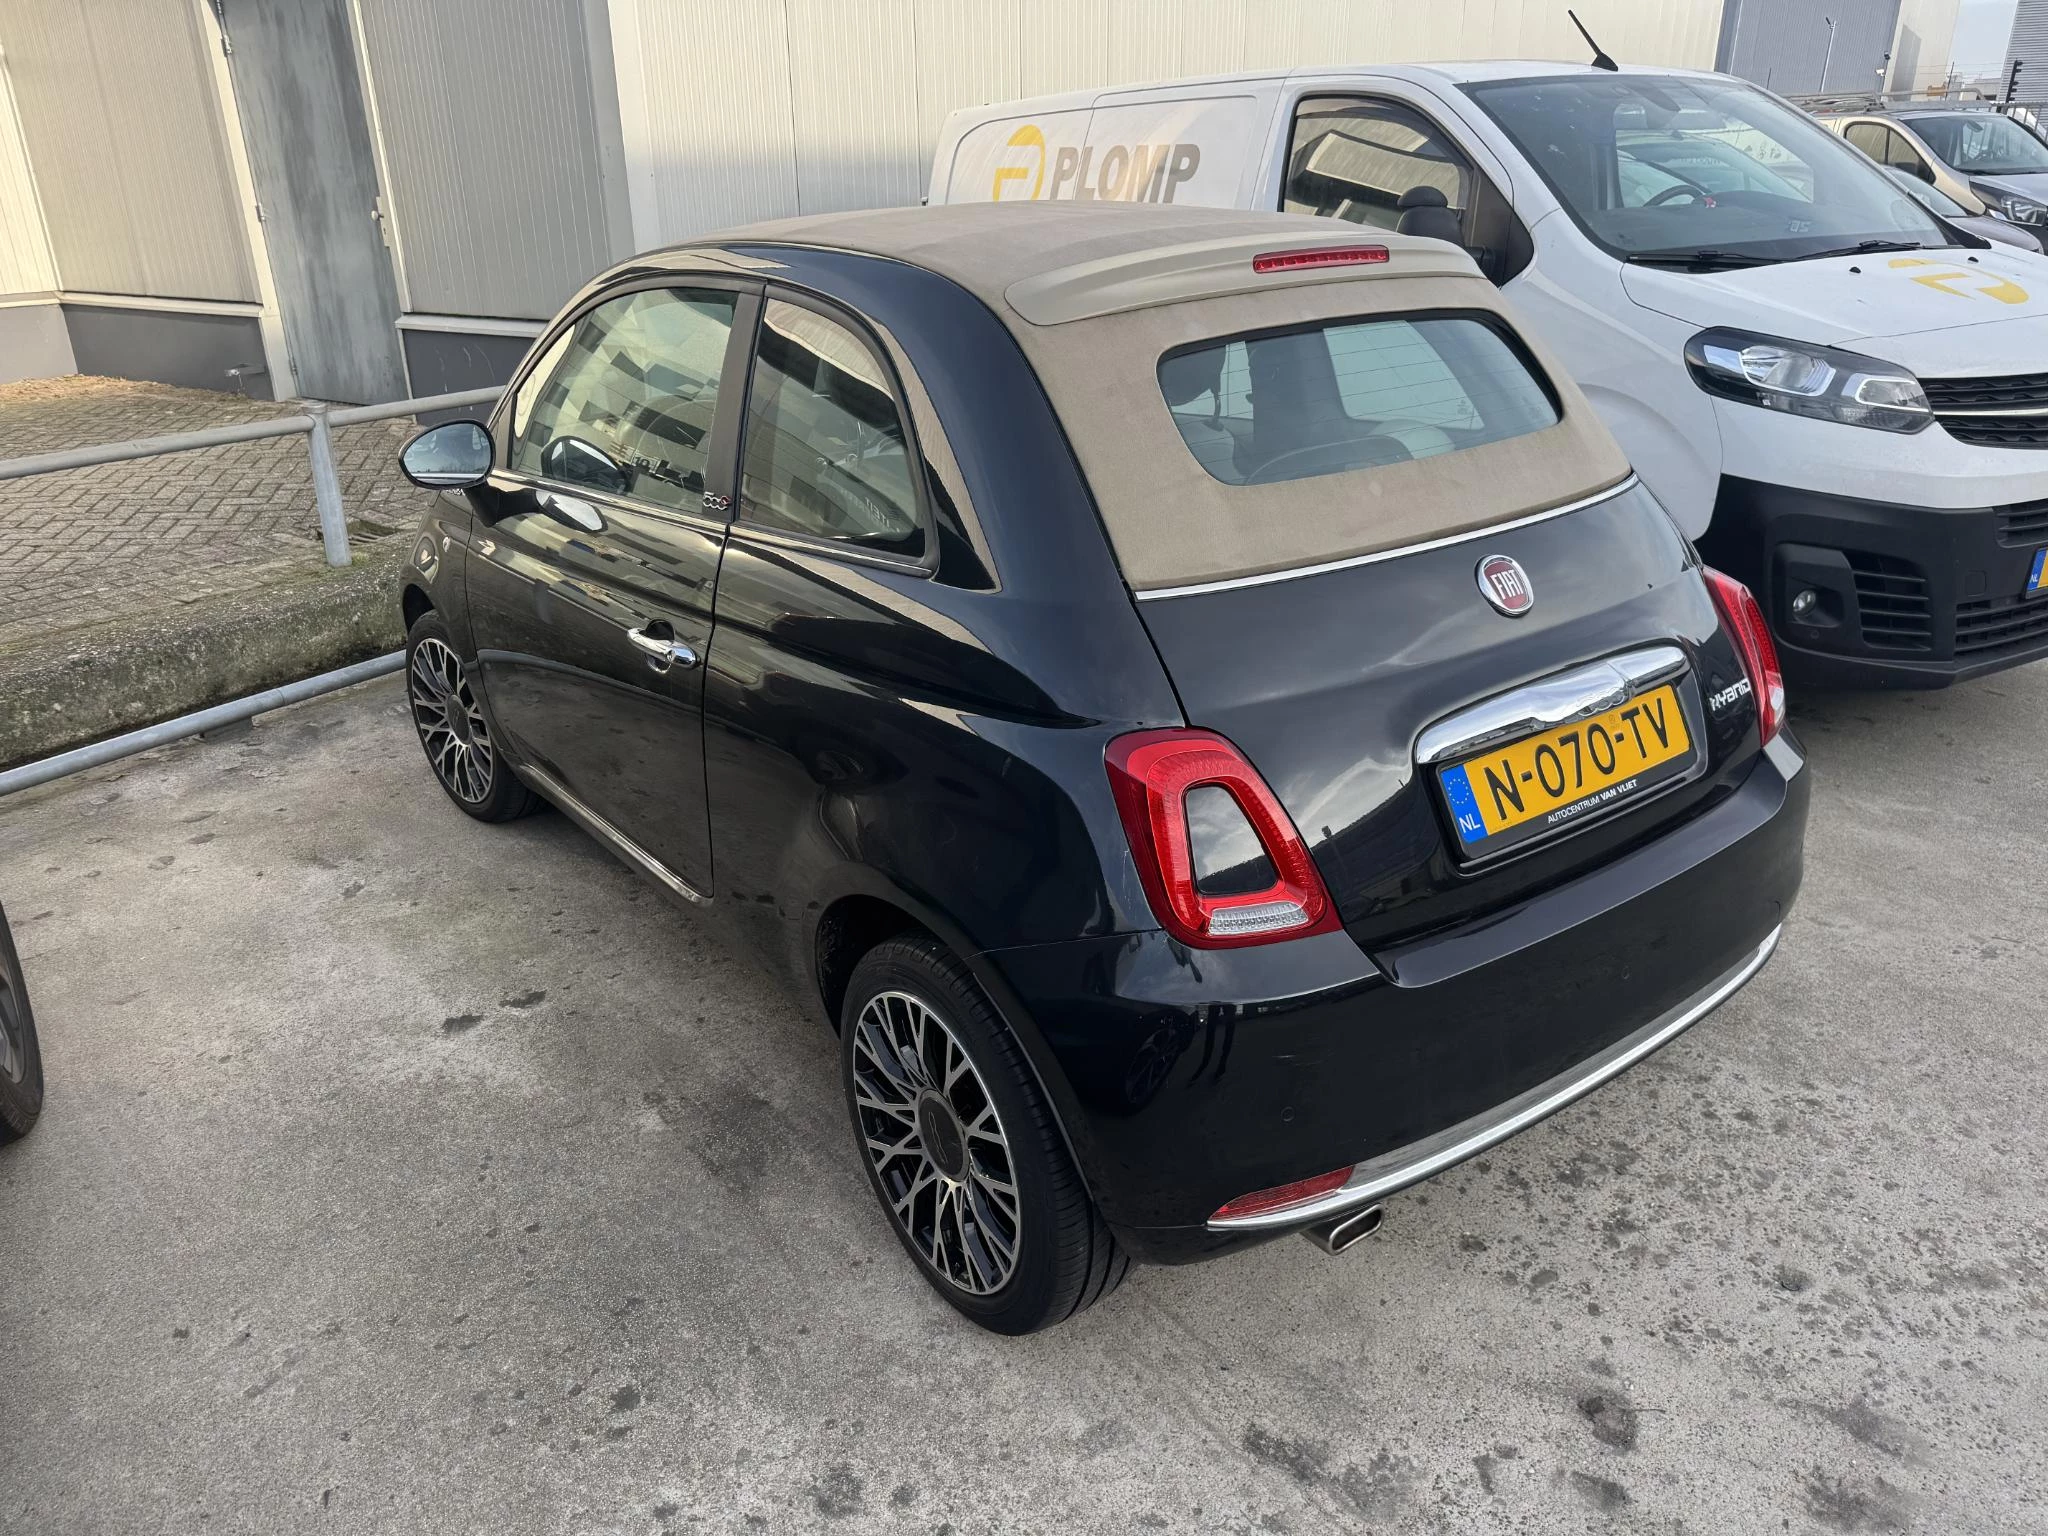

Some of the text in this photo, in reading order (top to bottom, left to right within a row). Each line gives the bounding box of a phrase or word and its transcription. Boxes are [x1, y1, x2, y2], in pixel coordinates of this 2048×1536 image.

[1050, 143, 1201, 204] PLOMP
[1490, 569, 1524, 600] FIAT
[1484, 697, 1669, 821] N-070-TV
[1459, 813, 1481, 834] NL
[1547, 779, 1637, 824] AUTOCENTRUM VAN VLIET
